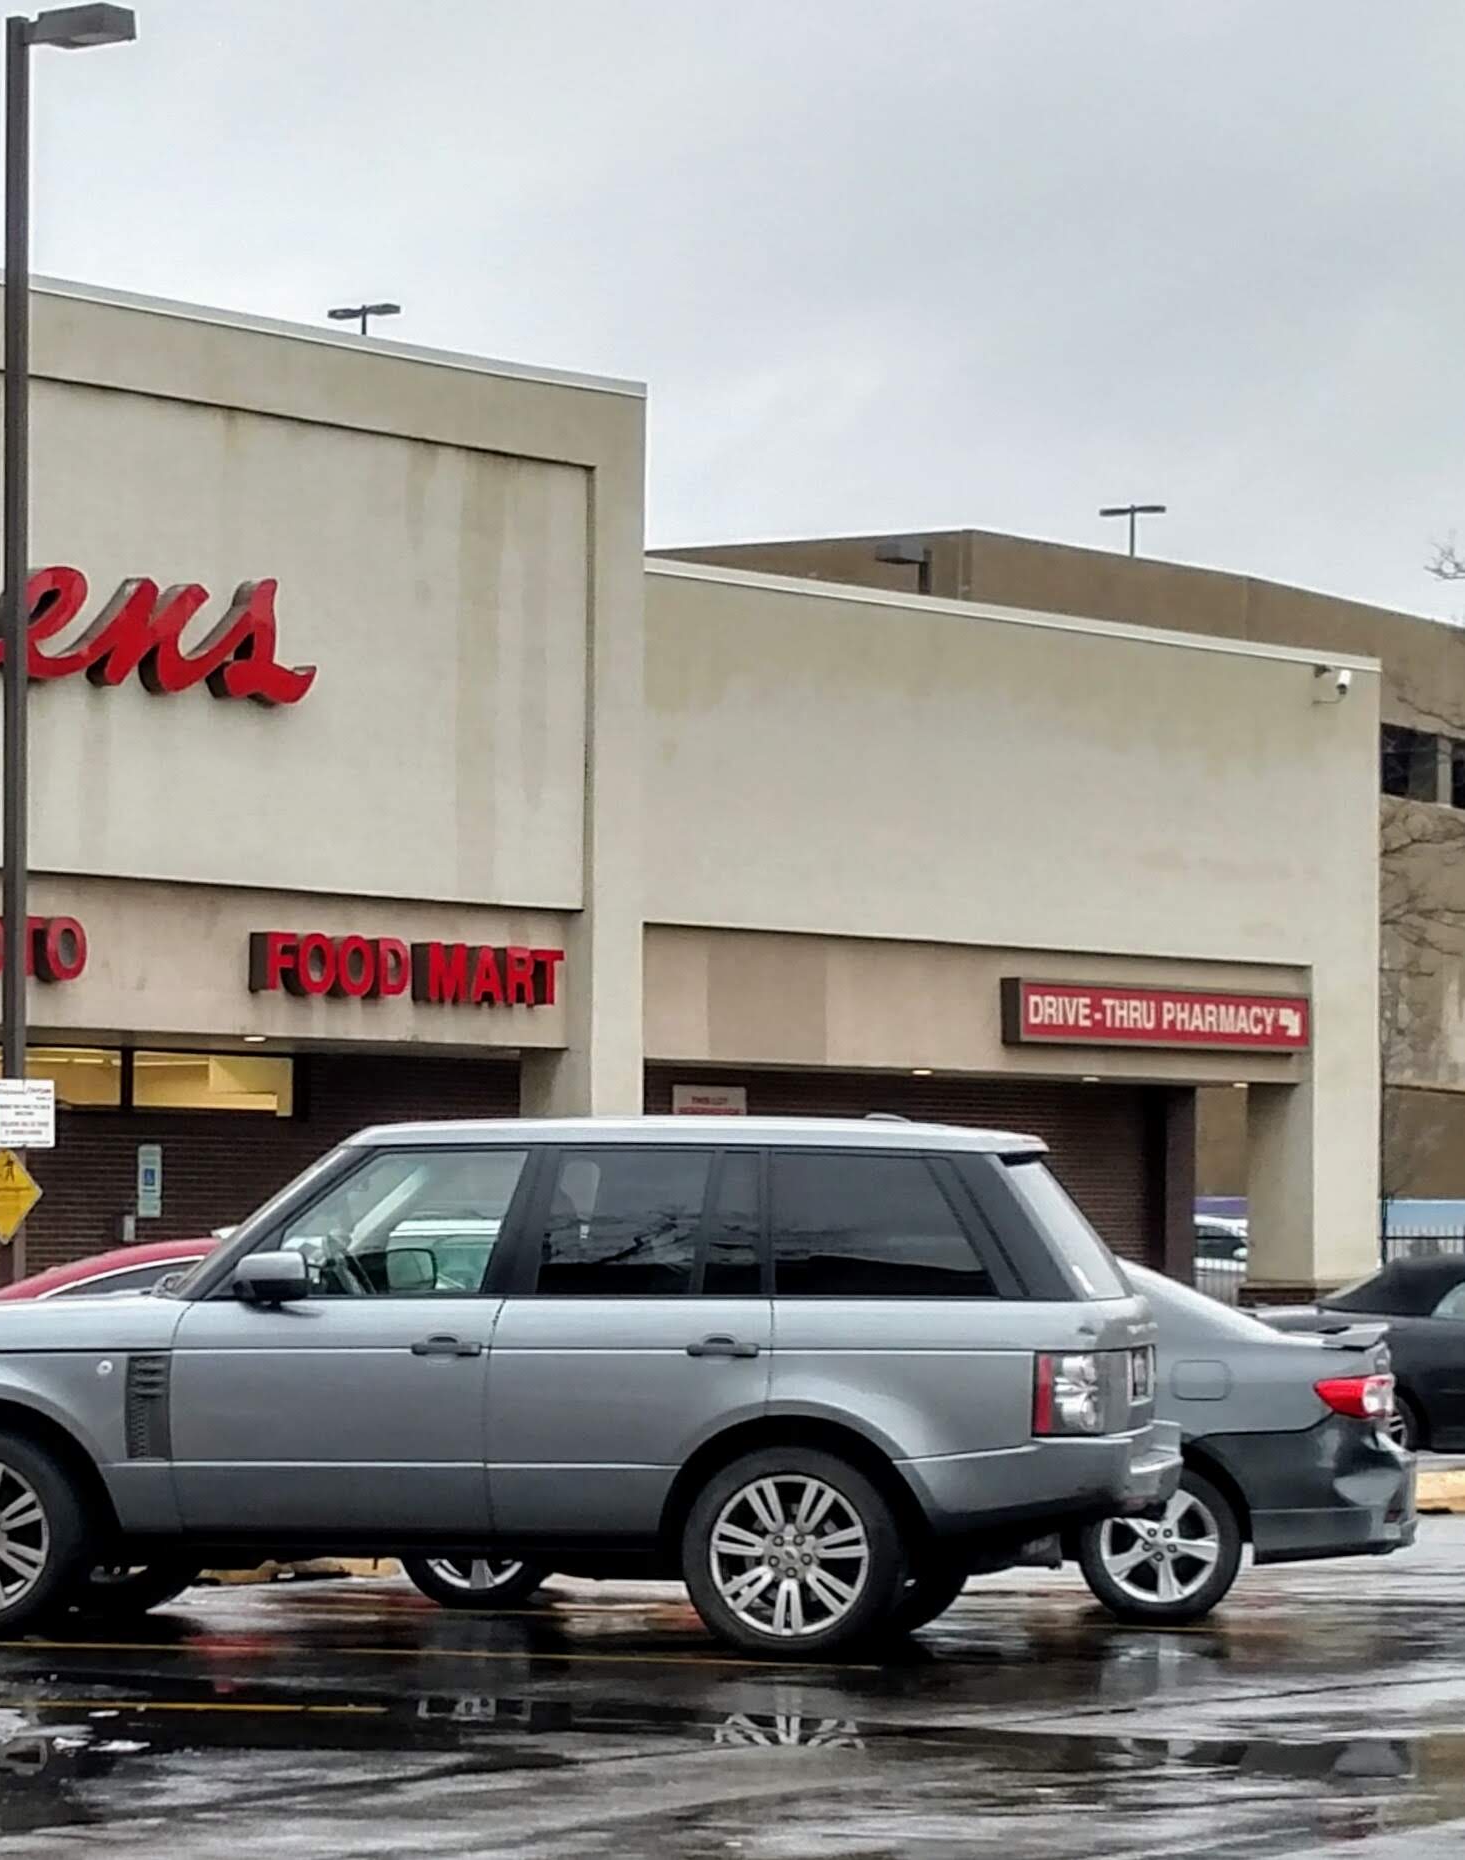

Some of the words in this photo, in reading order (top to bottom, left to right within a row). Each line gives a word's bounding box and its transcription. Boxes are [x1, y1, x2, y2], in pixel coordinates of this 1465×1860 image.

[249, 931, 410, 997] FOOD
[411, 942, 564, 1007] MART
[1162, 1001, 1277, 1035] PHARMACY
